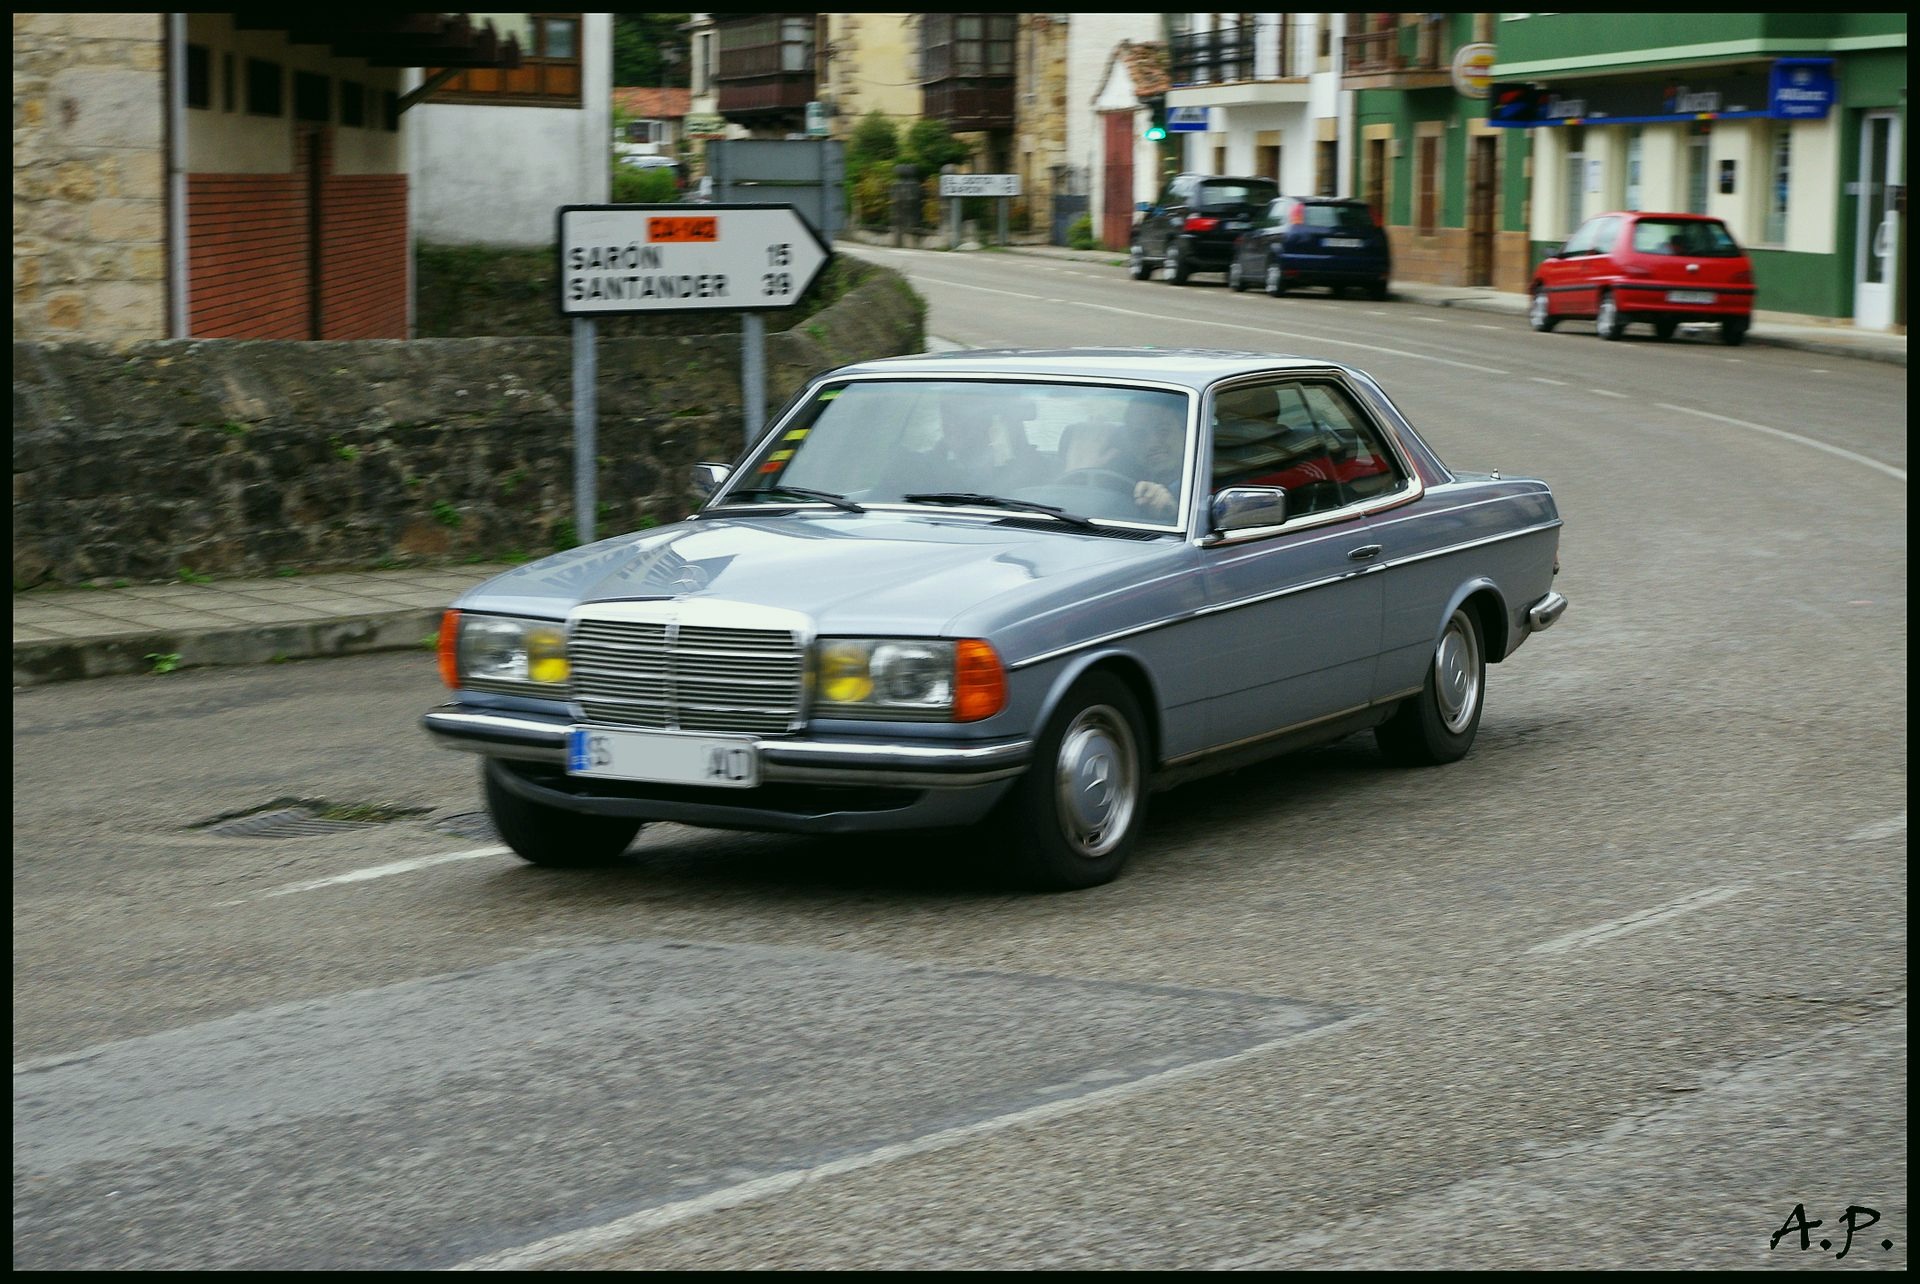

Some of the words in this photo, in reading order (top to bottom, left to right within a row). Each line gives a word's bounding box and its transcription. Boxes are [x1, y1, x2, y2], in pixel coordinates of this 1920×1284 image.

[568, 240, 662, 270] SARÓN
[766, 243, 793, 267] 15
[568, 274, 729, 300] SANTANDER
[762, 272, 793, 296] 39
